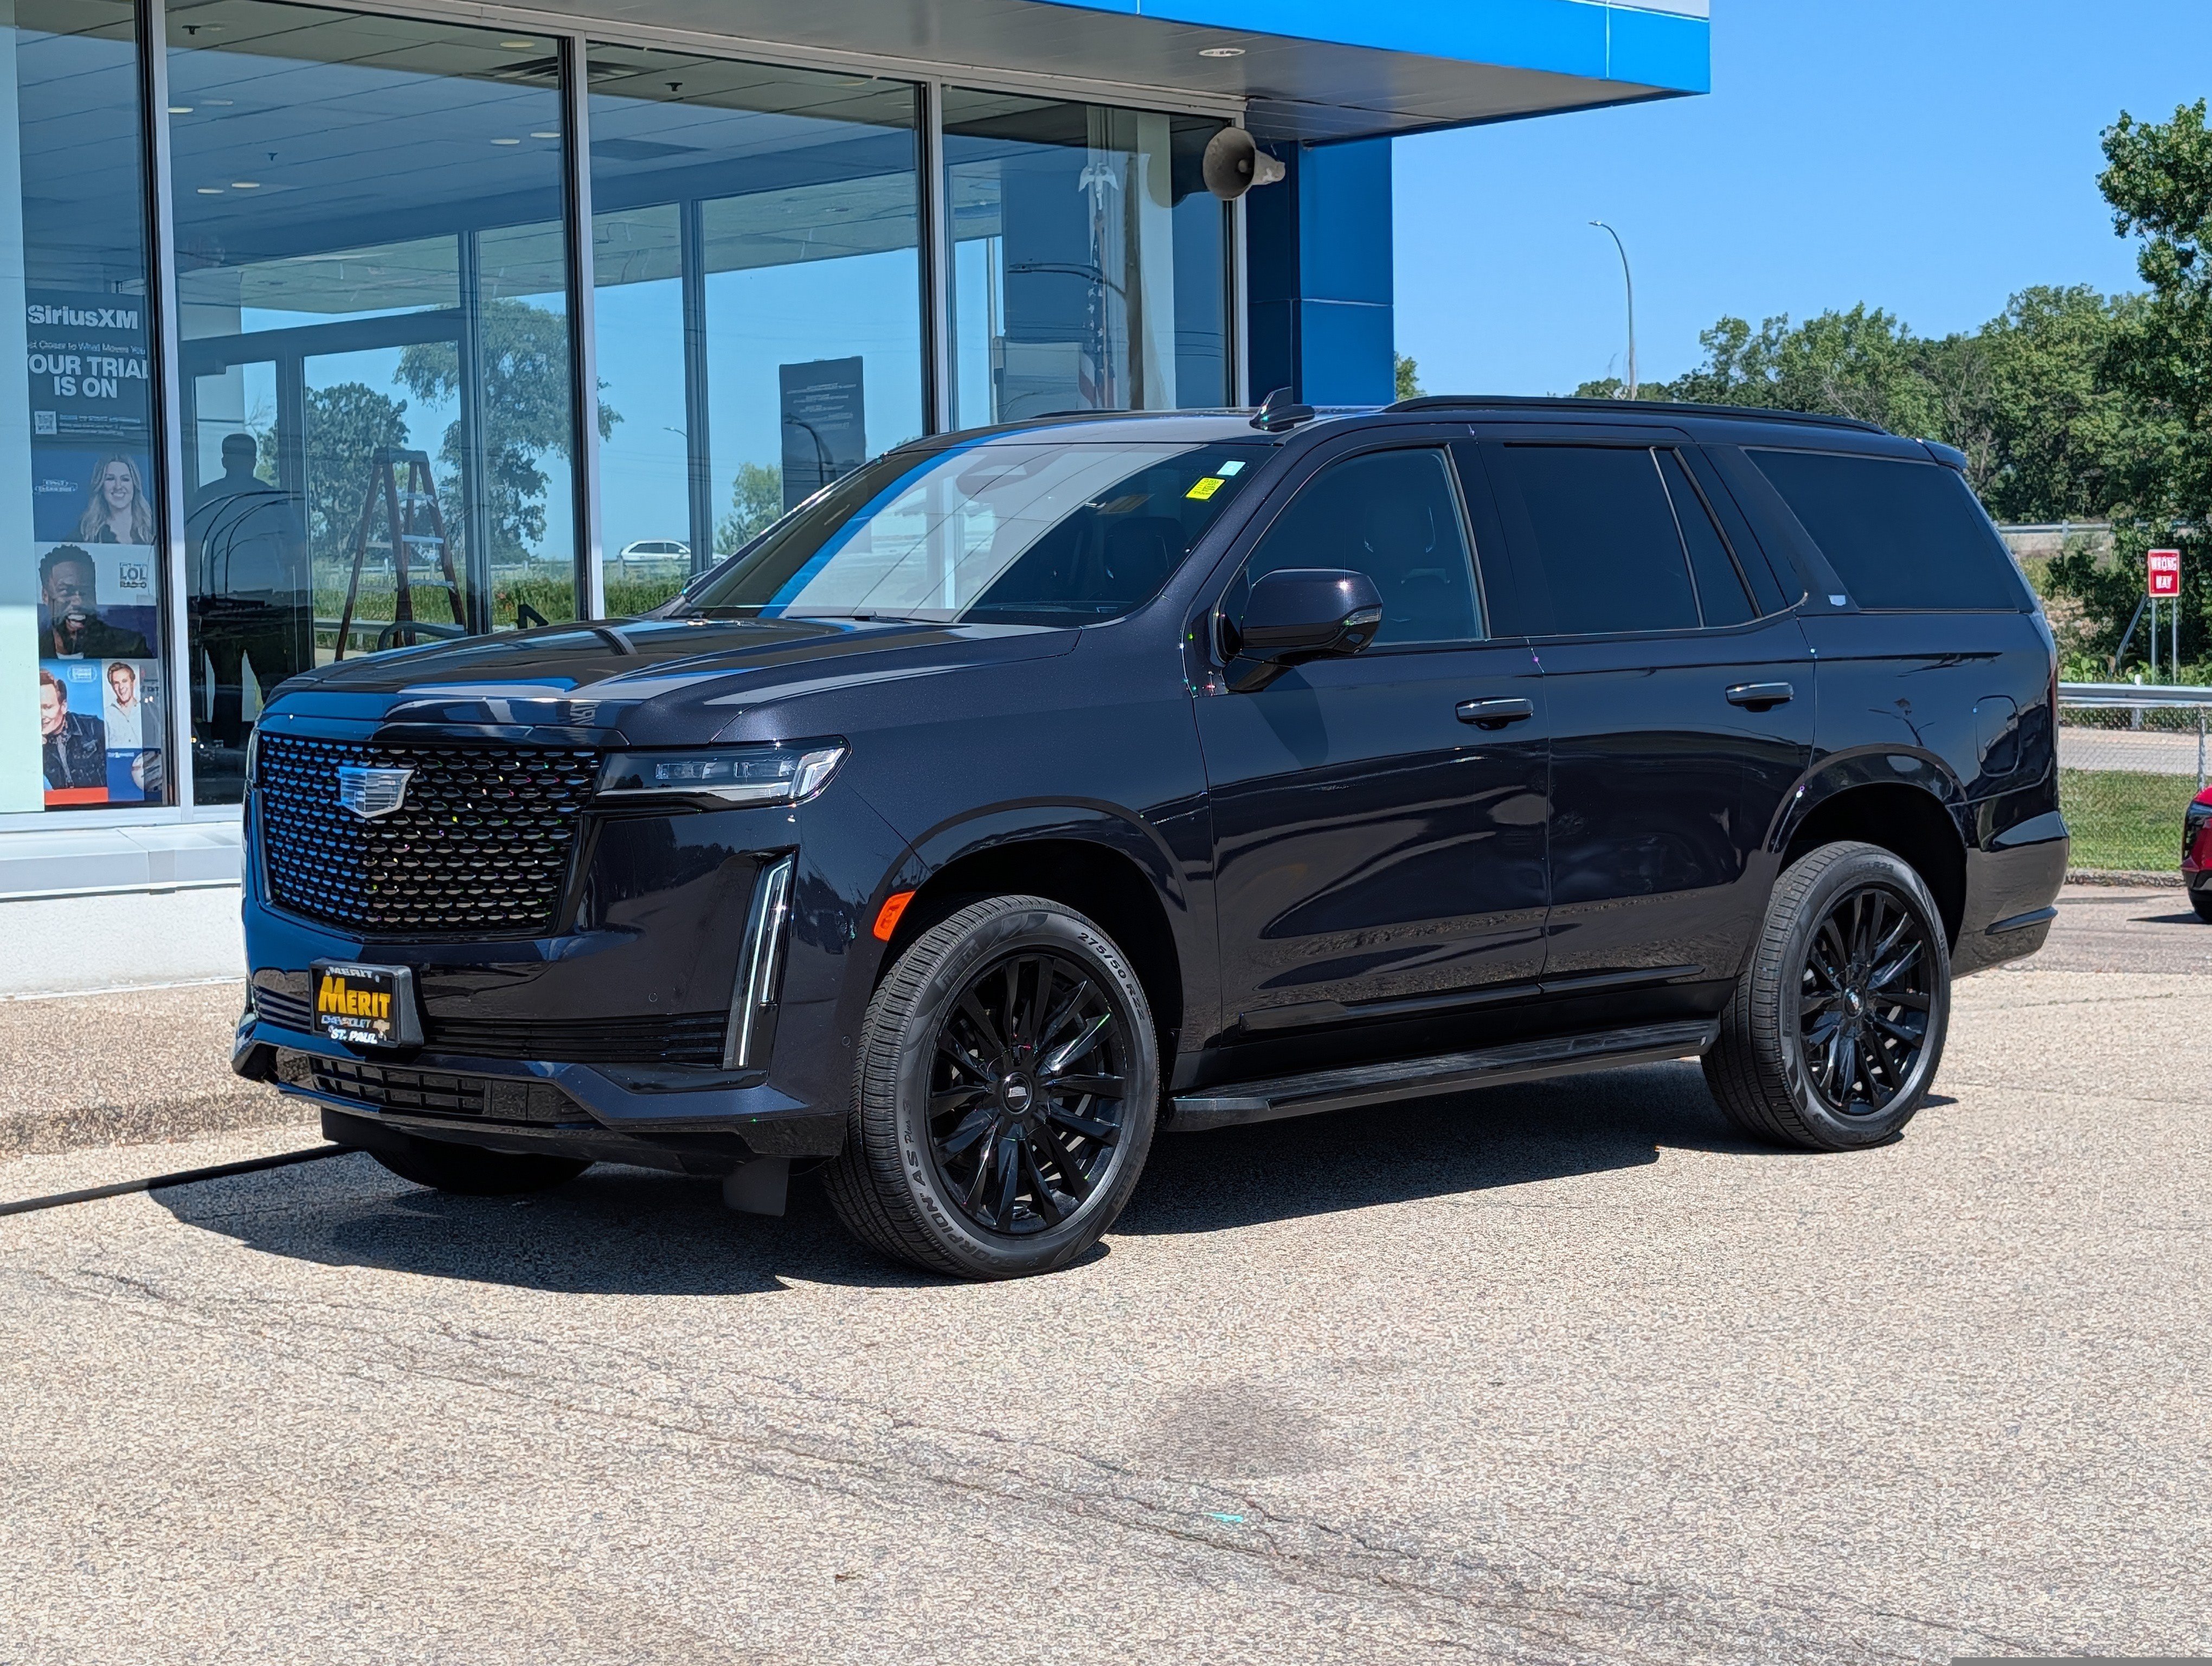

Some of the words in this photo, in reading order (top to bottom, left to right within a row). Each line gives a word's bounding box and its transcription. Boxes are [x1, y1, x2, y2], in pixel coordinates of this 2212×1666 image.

[28, 305, 138, 329] SiriusXM
[28, 354, 81, 375] OUR
[54, 376, 77, 396] IS
[82, 377, 117, 399] ON
[120, 567, 146, 581] LOL
[1077, 932, 1127, 979] 275/50
[1126, 983, 1145, 1021] R22
[318, 976, 391, 1018] MERIT
[330, 1029, 347, 1041] ST.
[348, 1031, 378, 1045] PAUL
